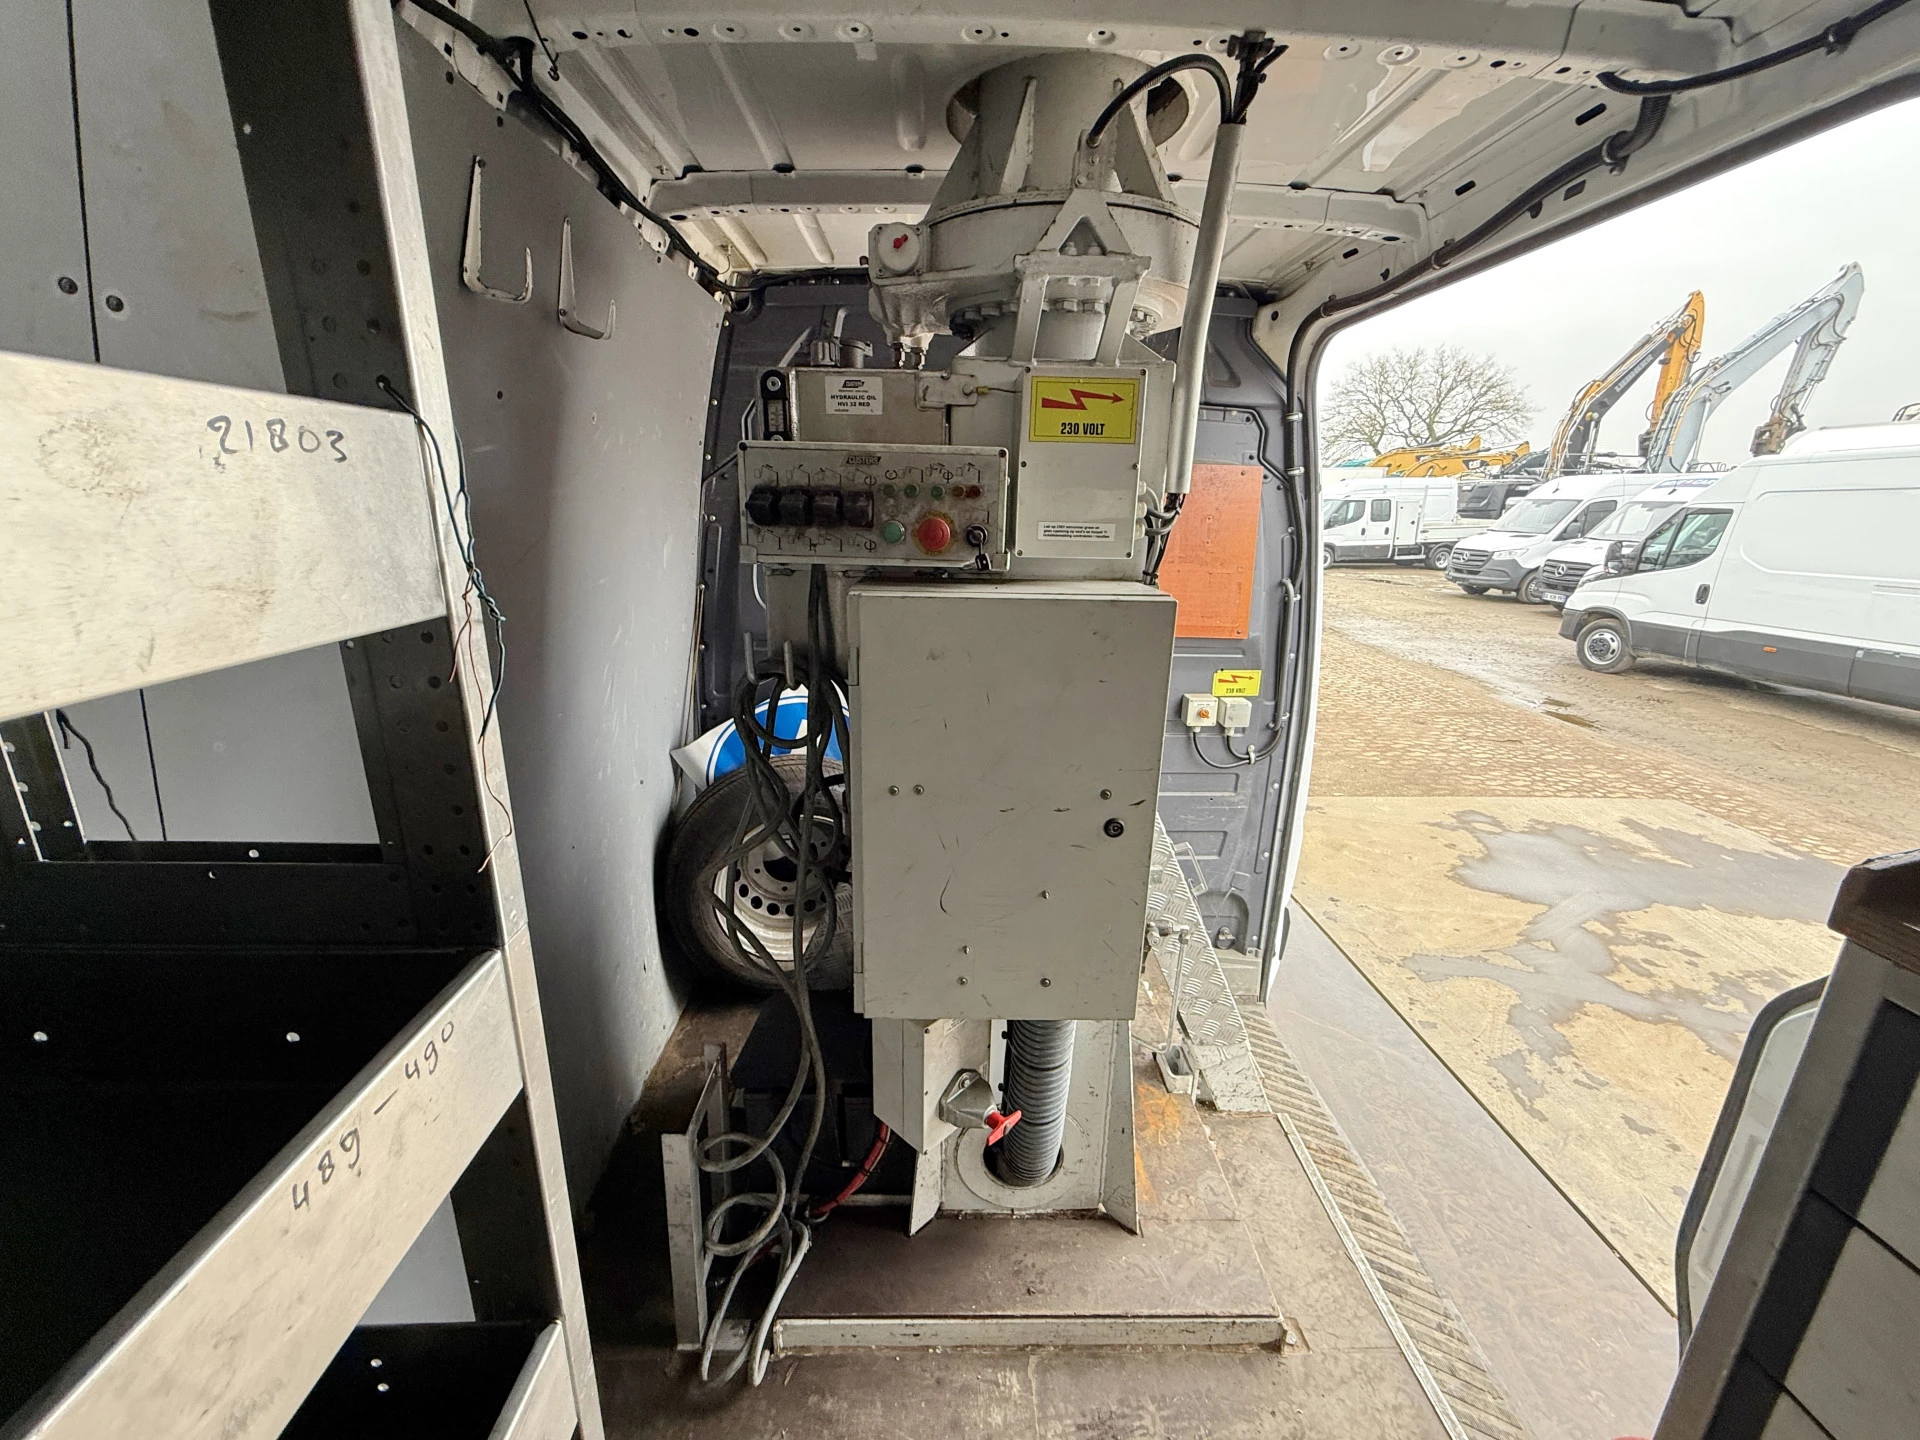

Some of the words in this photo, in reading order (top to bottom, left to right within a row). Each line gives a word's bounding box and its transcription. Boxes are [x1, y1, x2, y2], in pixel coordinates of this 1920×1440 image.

[206, 414, 348, 464] 21803
[1060, 422, 1080, 435] 230
[1082, 423, 1105, 436] VOLT
[291, 1127, 361, 1210] 489
[404, 1020, 455, 1080] 490
